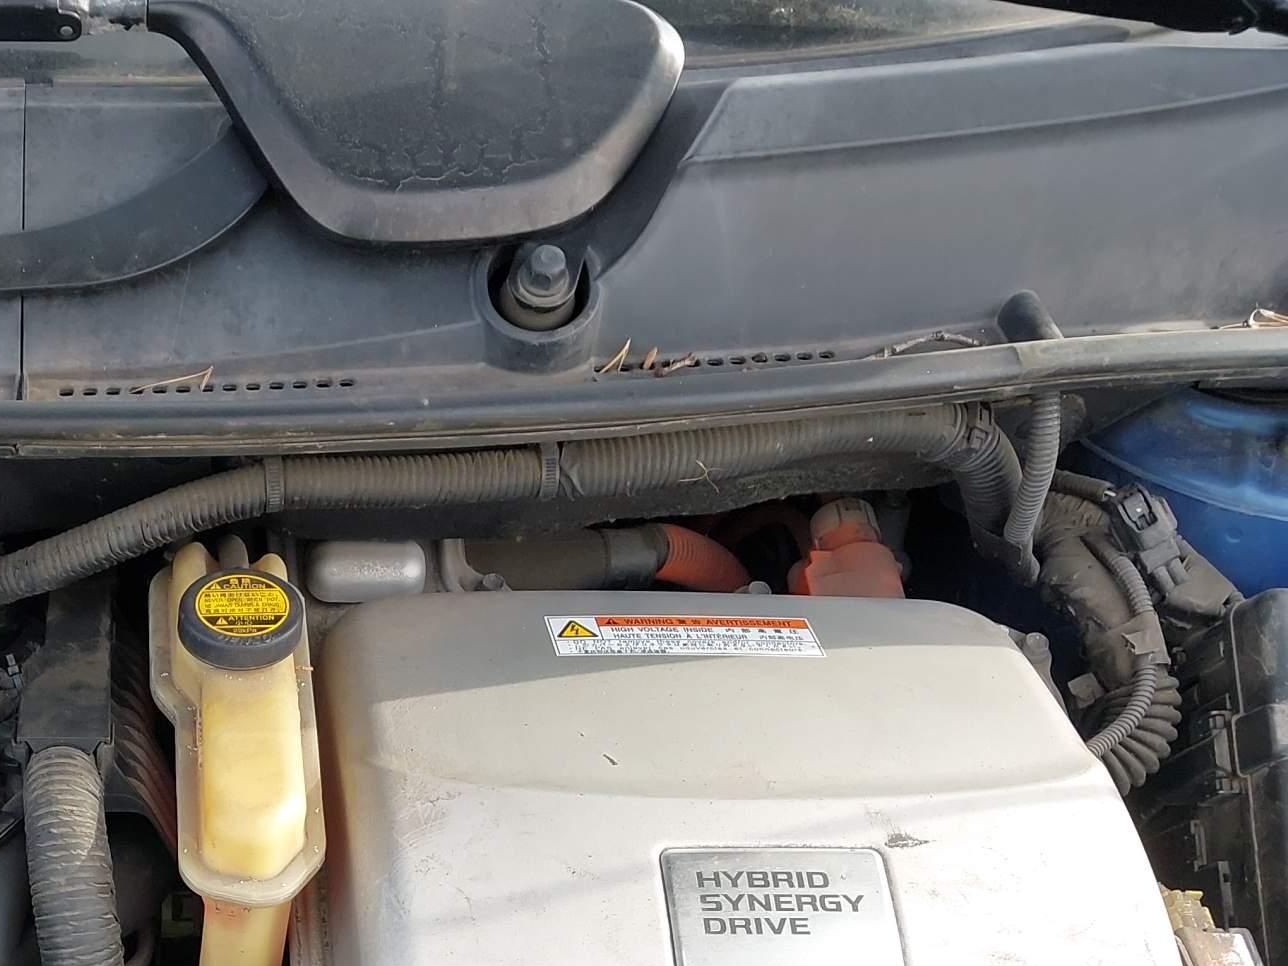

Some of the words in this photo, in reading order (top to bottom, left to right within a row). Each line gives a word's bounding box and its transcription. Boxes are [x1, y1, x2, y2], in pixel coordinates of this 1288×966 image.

[706, 619, 792, 627] AVERTISSEMENT
[695, 870, 830, 888] HYBRID
[699, 894, 864, 913] SYNERGY
[703, 917, 811, 935] DRIVE
